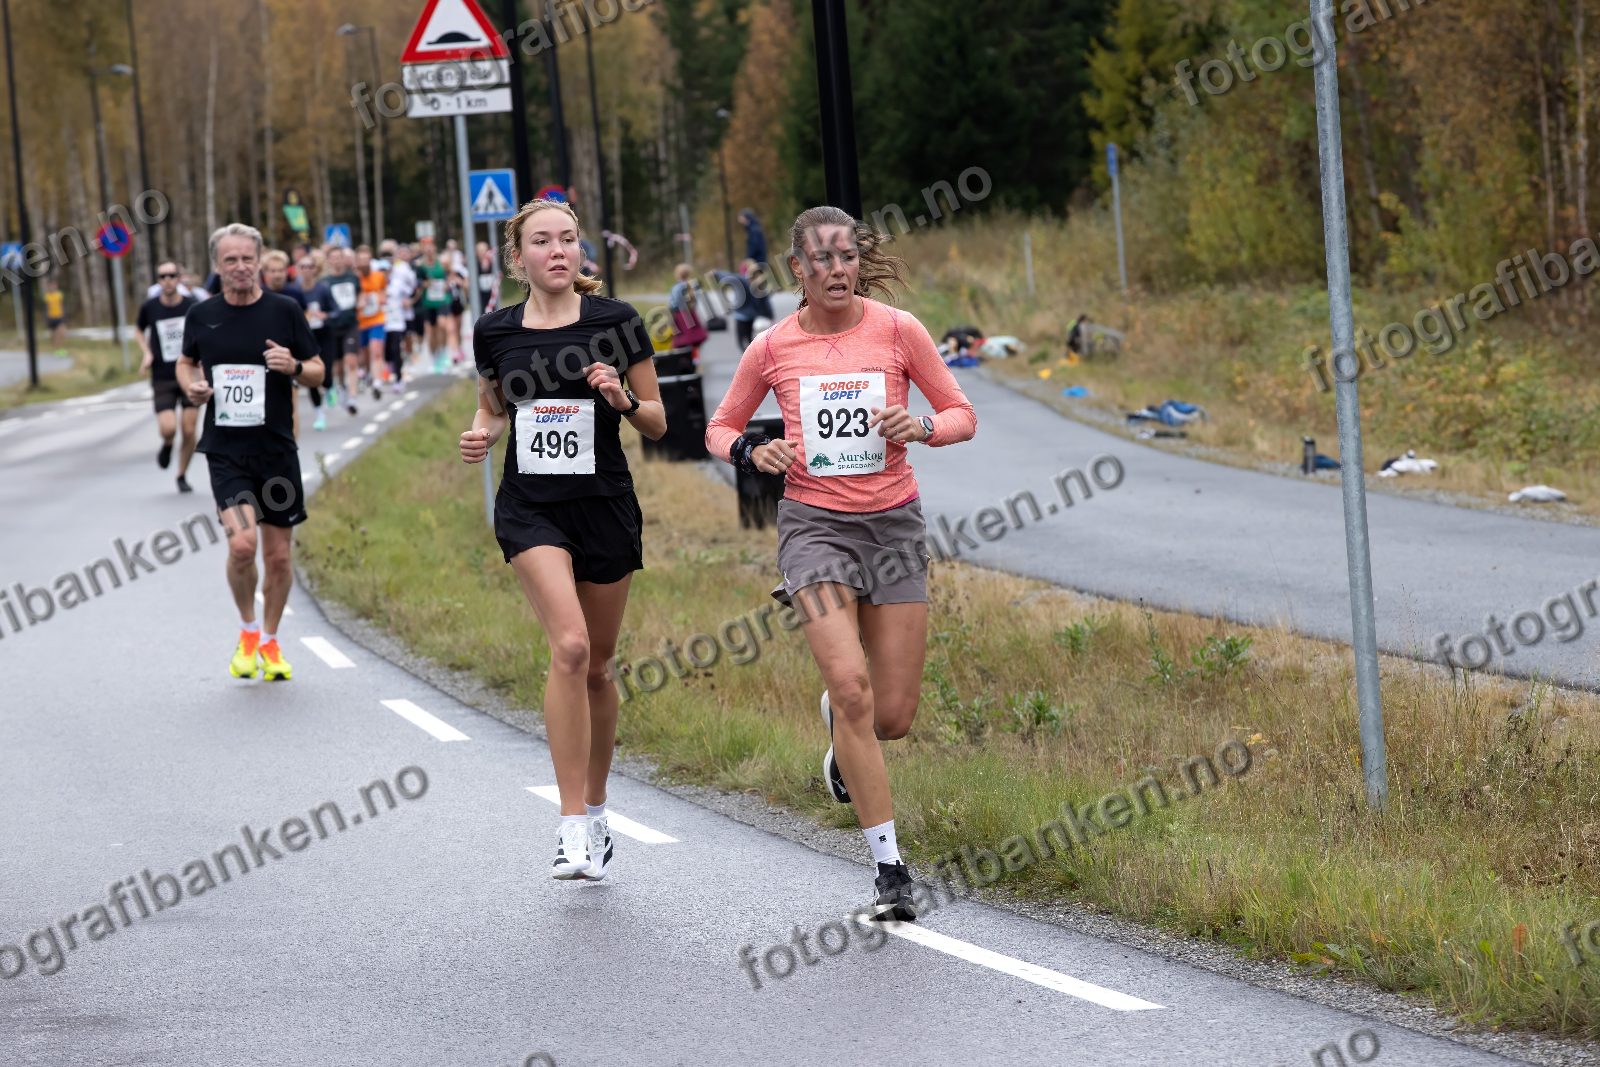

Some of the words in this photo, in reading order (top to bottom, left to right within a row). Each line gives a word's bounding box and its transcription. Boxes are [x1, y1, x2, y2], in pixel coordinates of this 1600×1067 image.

[456, 96, 461, 109] 1
[466, 95, 488, 108] km
[819, 380, 870, 391] NORGES
[222, 385, 253, 404] 709
[823, 390, 862, 401] LØPET
[533, 405, 580, 414] NORGES
[536, 414, 573, 424] LØPET
[817, 407, 870, 439] 923
[530, 430, 579, 459] 496
[838, 451, 883, 462] Aurskog
